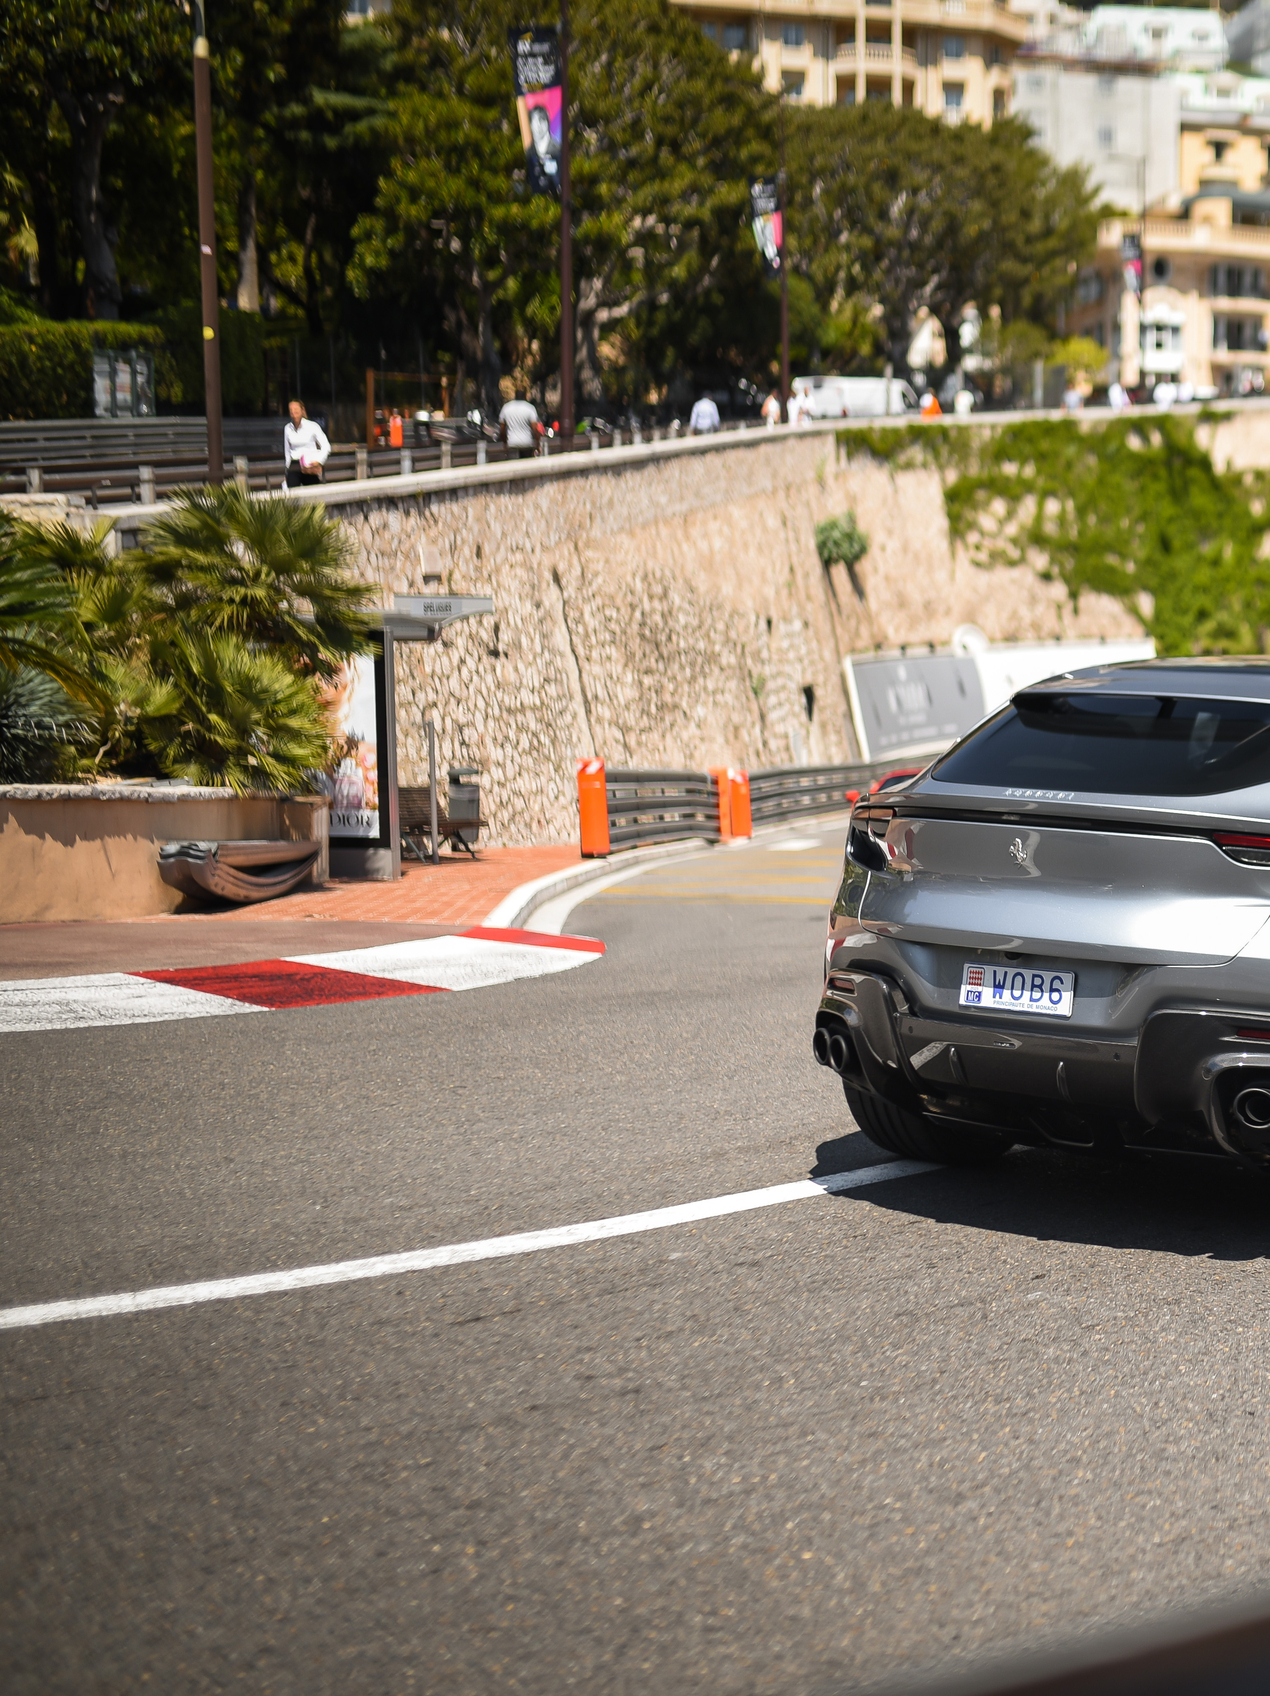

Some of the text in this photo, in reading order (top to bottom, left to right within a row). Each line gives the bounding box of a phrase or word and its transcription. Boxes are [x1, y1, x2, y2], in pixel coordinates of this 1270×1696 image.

[329, 811, 372, 828] DIOR
[967, 991, 980, 1001] MC
[1035, 1004, 1058, 1012] MONACO
